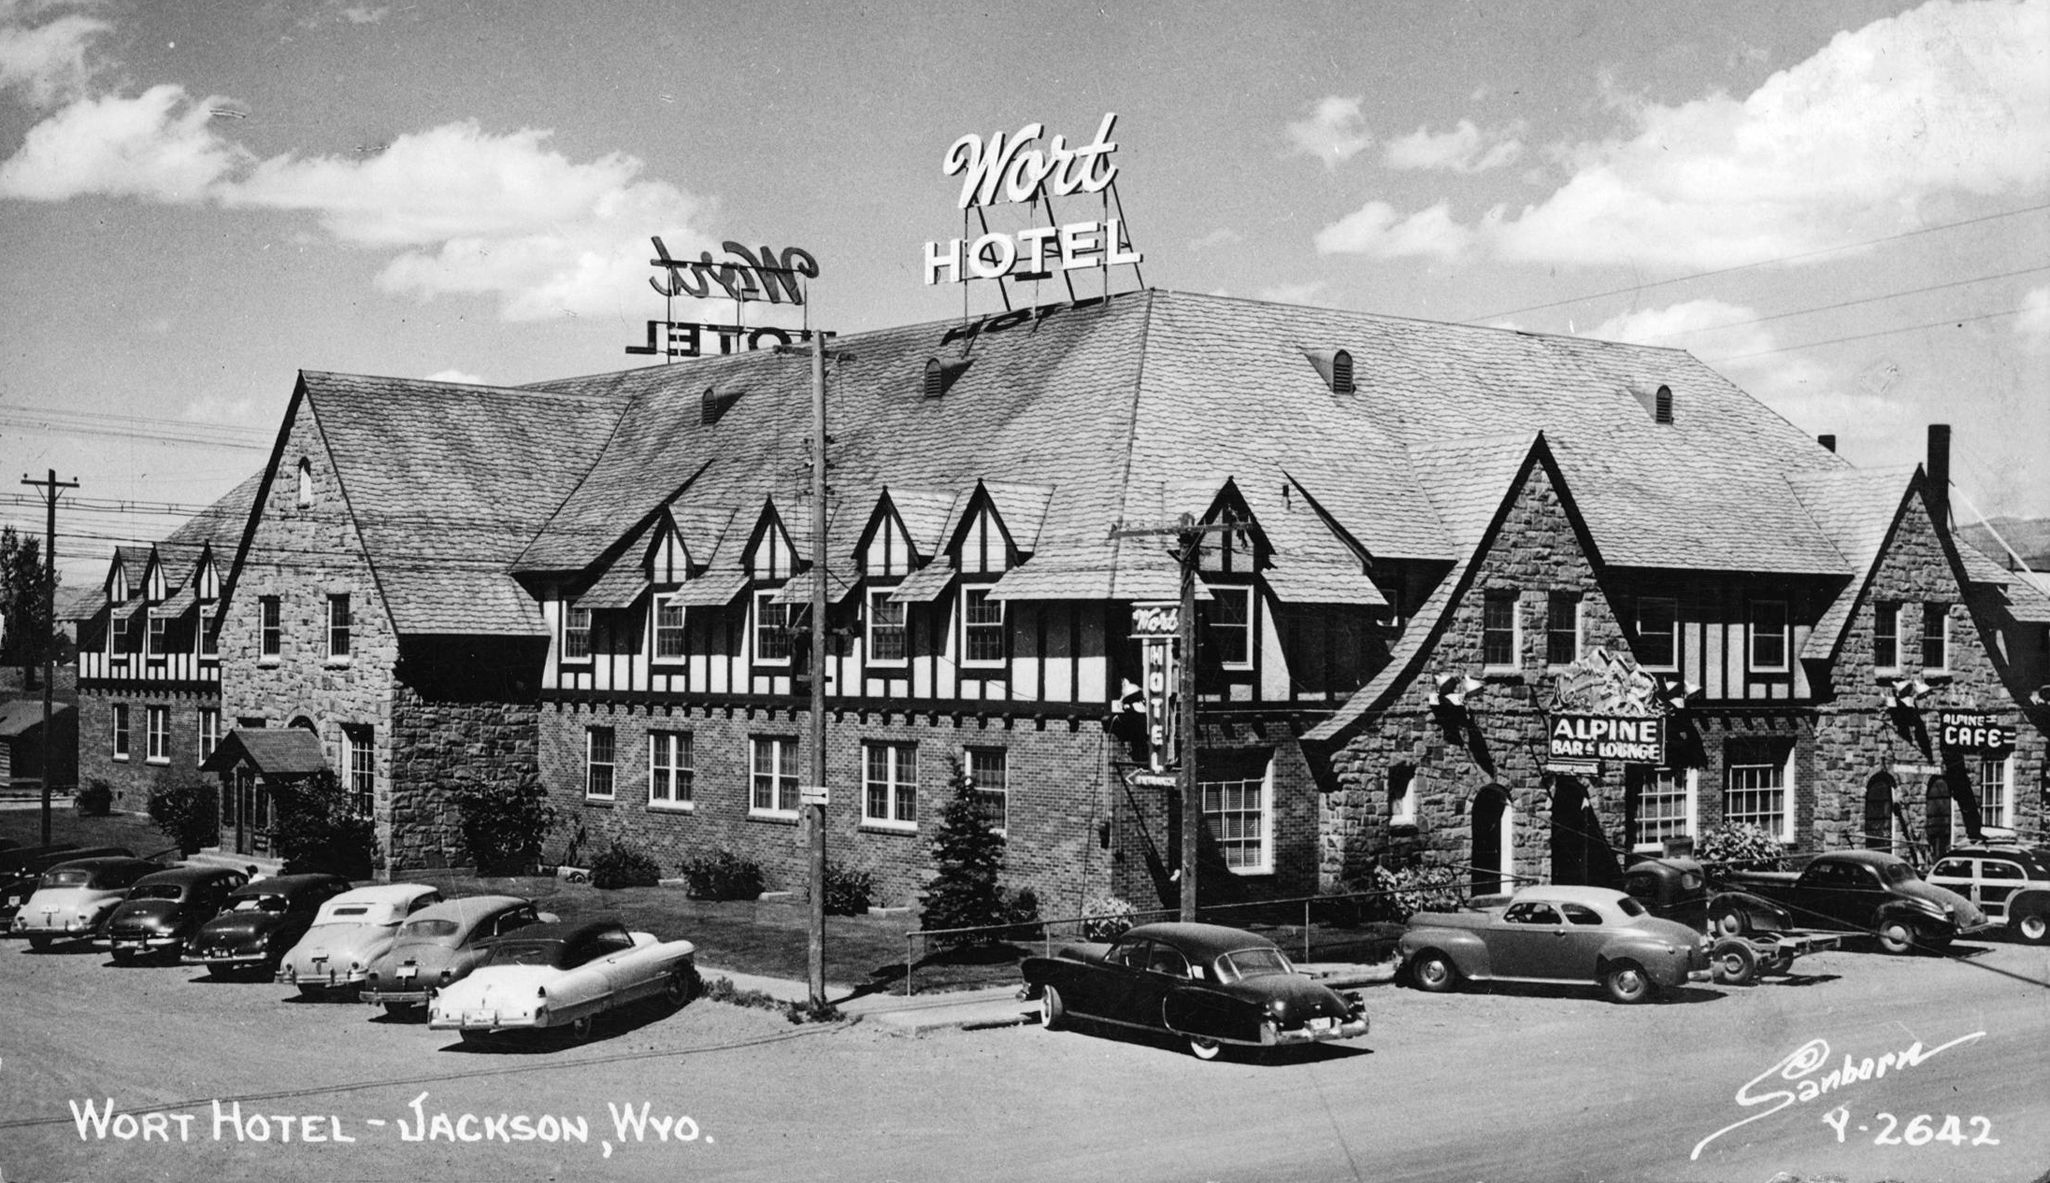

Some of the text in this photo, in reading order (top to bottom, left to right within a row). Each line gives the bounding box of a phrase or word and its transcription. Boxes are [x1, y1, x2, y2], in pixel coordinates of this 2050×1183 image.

[943, 112, 1120, 208] Wort
[924, 218, 1144, 284] HOTEL
[1150, 645, 1164, 774] HOTEL
[1943, 714, 1985, 726] ALPINE
[1554, 718, 1657, 742] ALPINE
[1945, 727, 2001, 748] CAFE
[1551, 740, 1583, 755] BAR
[1598, 743, 1660, 760] LOUNGE
